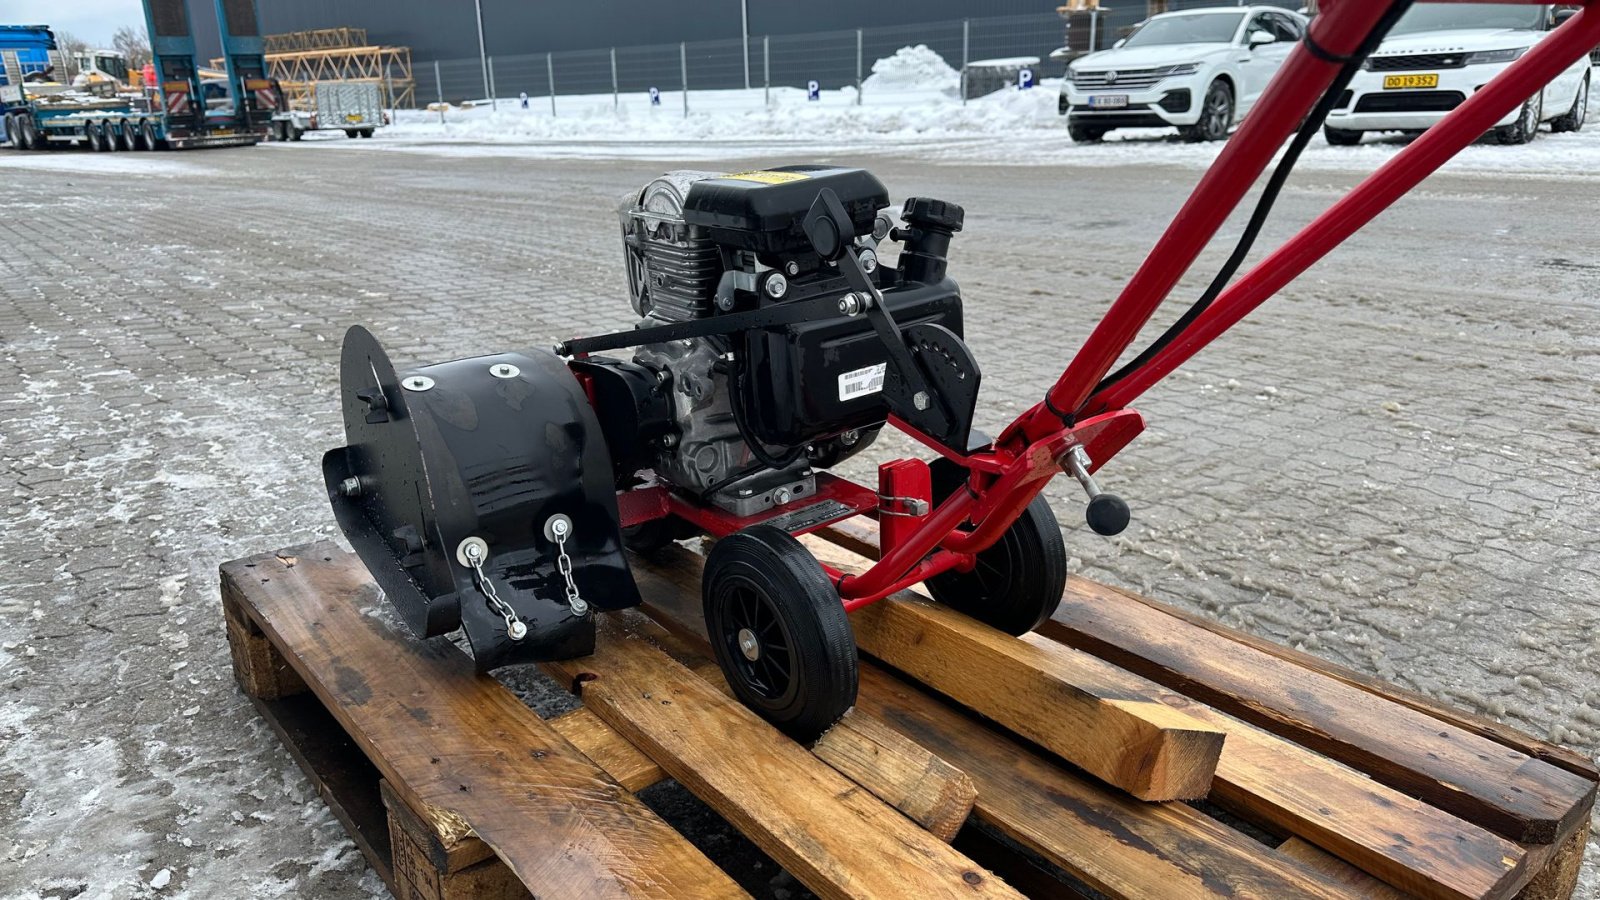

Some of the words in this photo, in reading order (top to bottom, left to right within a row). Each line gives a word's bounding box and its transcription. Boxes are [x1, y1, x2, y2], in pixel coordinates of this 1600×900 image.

[1019, 70, 1032, 87] P
[649, 87, 659, 101] P
[808, 80, 819, 96] P
